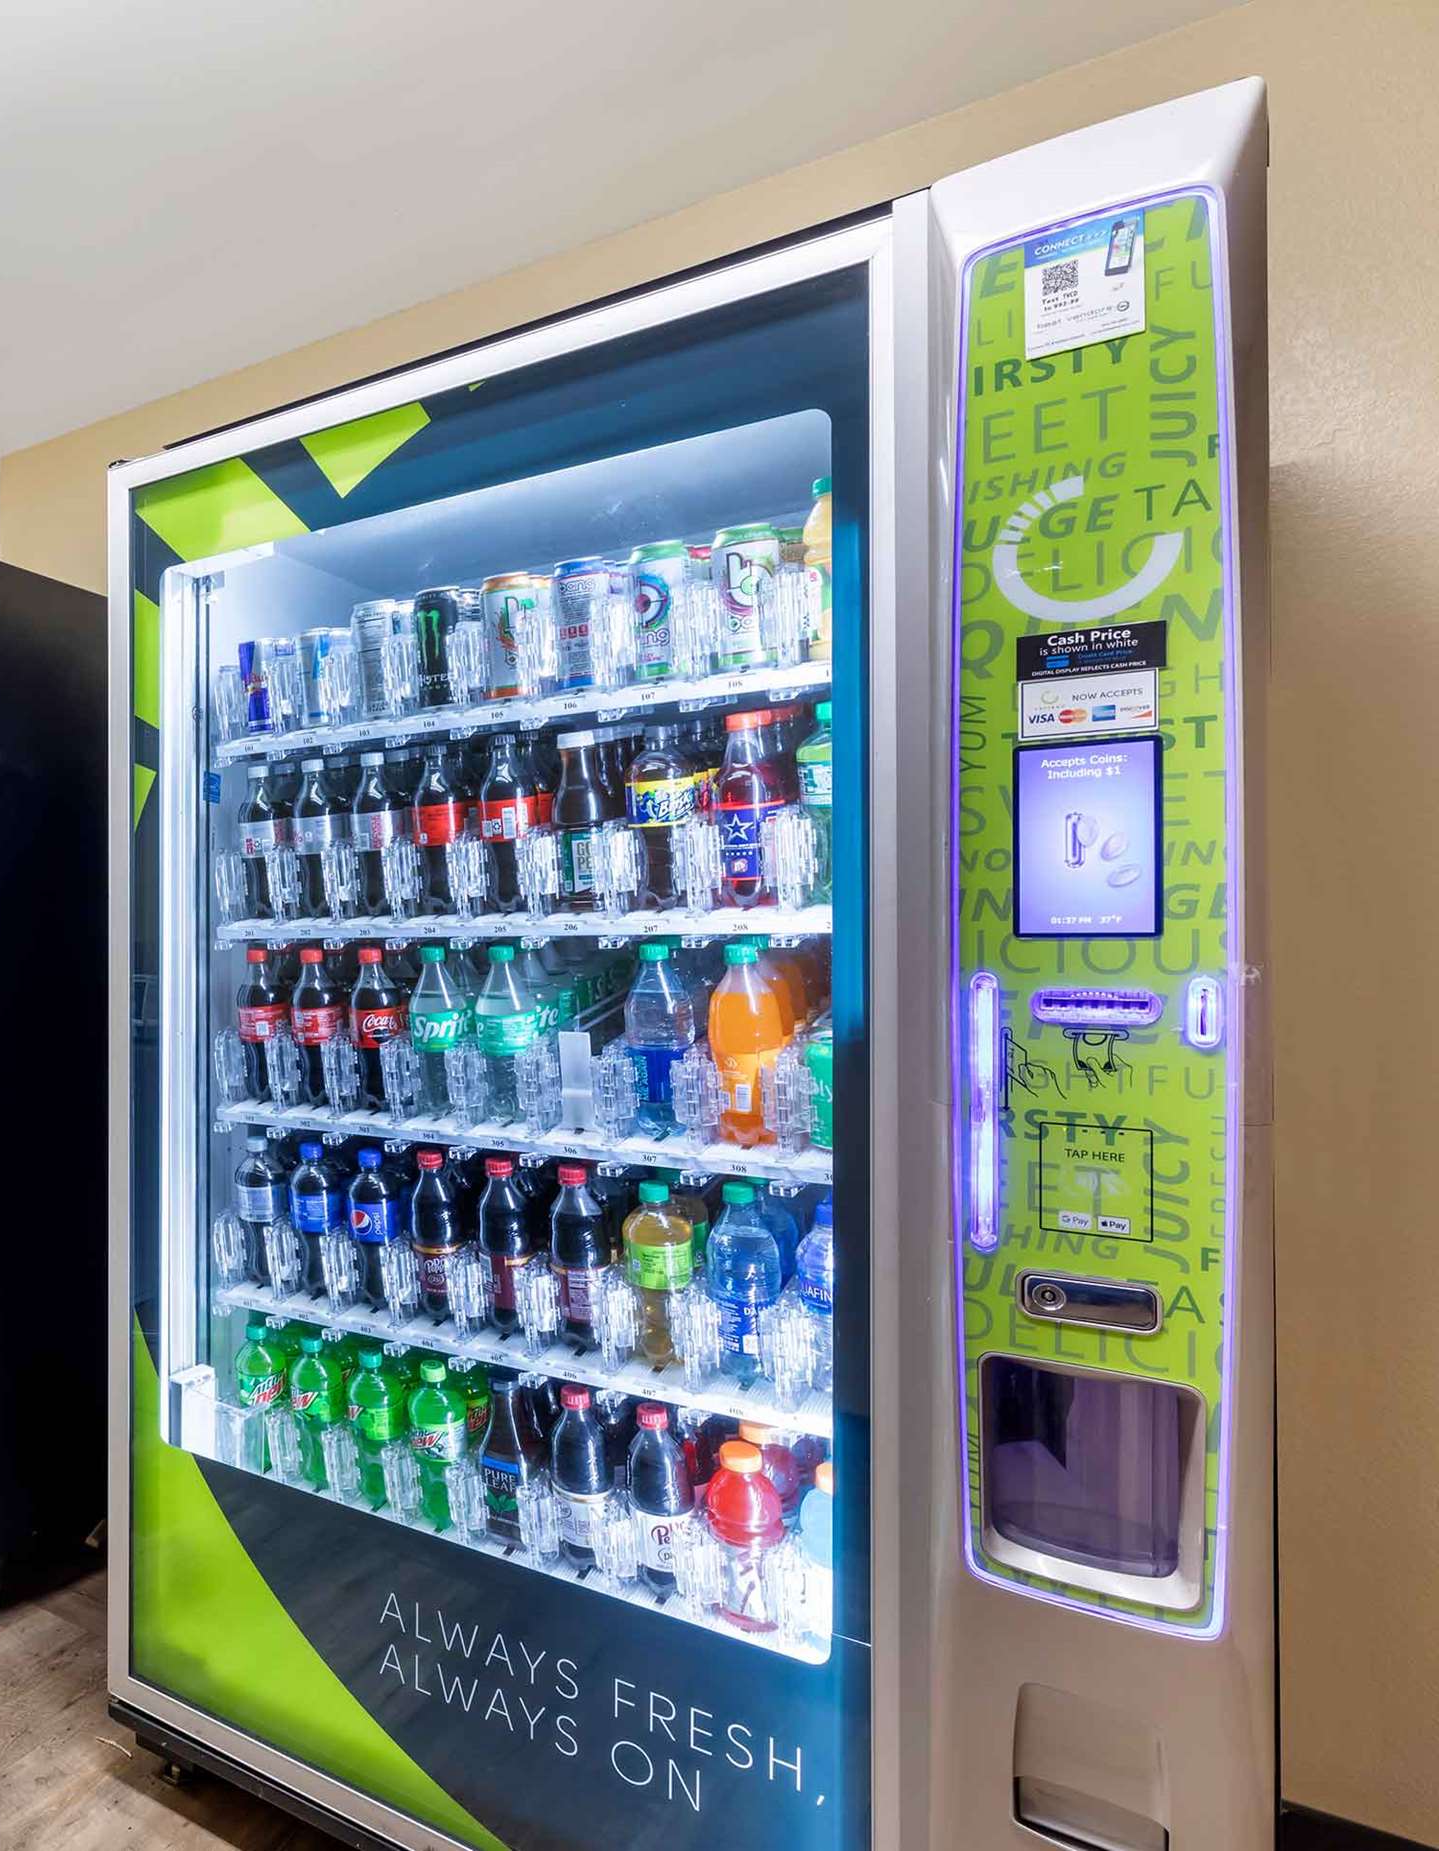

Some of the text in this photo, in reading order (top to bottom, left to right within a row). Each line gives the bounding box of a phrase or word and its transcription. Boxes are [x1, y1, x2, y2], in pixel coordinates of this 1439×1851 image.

[1034, 234, 1085, 256] CONNECT
[1149, 324, 1198, 467] JUICY
[1047, 628, 1132, 647] Cash Price
[1040, 638, 1139, 656] is shown in white
[1031, 669, 1055, 677] DIGITAL
[1055, 666, 1080, 675] DISPLAY
[1080, 663, 1110, 673] REFLECTS
[1110, 661, 1128, 670] CASH
[1128, 659, 1147, 668] PRICE
[641, 692, 656, 701] 107
[1072, 687, 1143, 702] NOW ACCEPTS
[563, 701, 577, 710] 106
[1028, 713, 1055, 724] VISA
[1041, 753, 1129, 768] Accepts Coins:
[1047, 765, 1121, 779] Including $1
[423, 926, 436, 935] 204
[494, 926, 507, 934] 205
[563, 923, 578, 932] 206
[643, 925, 658, 934] 207
[642, 1154, 657, 1164] 307
[1064, 1148, 1126, 1163] TAP HERE
[730, 1163, 747, 1174] 308
[372, 1211, 384, 1236] pepsi
[1072, 1216, 1089, 1228] Pay
[1109, 1220, 1127, 1231] Pay
[484, 1467, 517, 1483] PURE
[380, 1592, 825, 1807] ALWAYS FRESH,
[380, 1643, 702, 1812] ALWAYS ON
